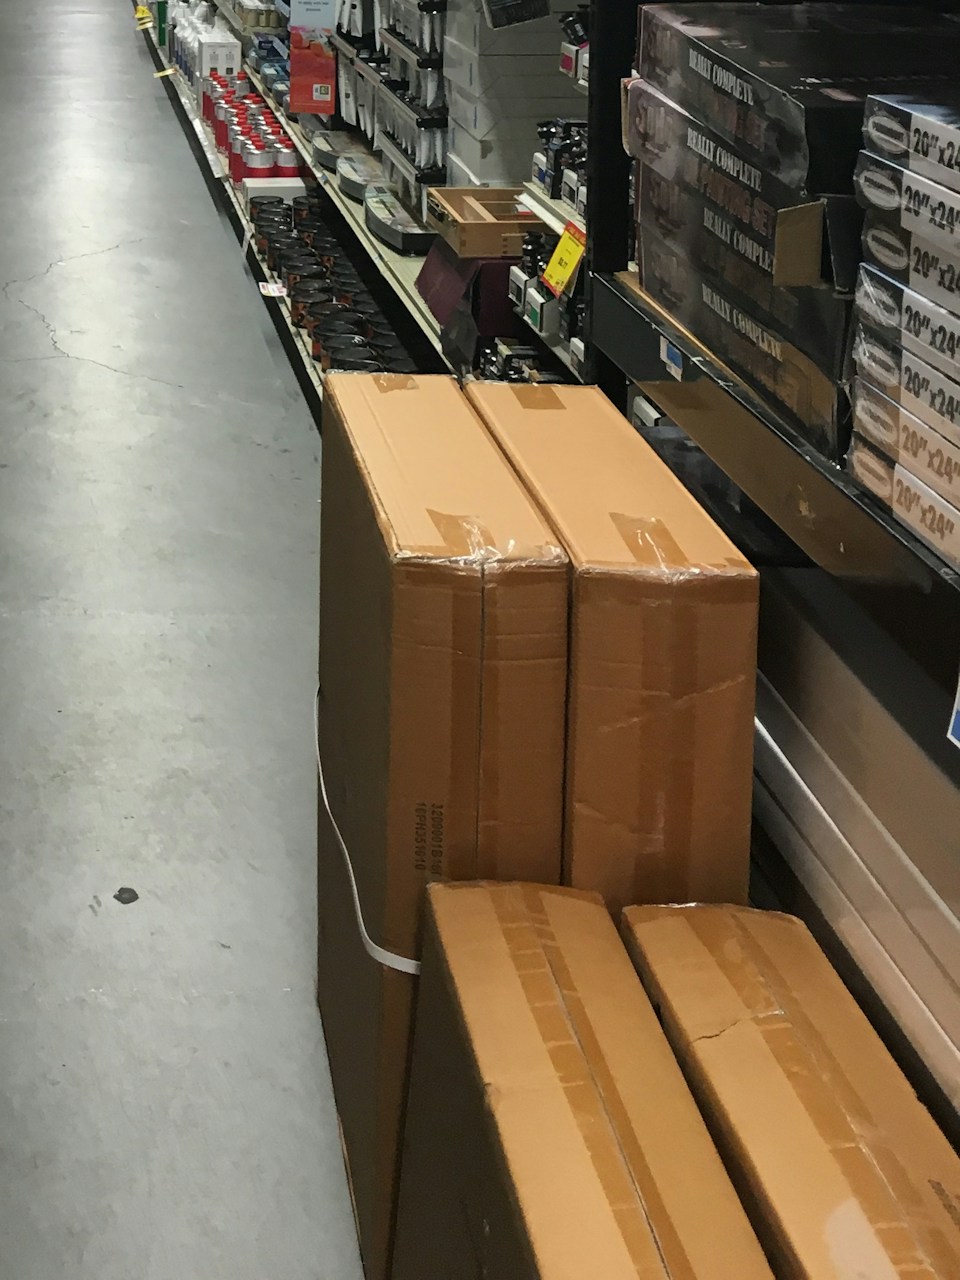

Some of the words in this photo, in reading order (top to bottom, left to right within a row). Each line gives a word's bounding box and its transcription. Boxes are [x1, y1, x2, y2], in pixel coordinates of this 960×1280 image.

[712, 64, 754, 106] COMPLETE
[687, 127, 716, 162] REALLY
[715, 146, 762, 193] COMPLETE
[703, 207, 732, 244] REALLY
[702, 283, 731, 323] REALLY
[733, 313, 784, 363] COMPLETE
[896, 478, 955, 540] 20"x24"
